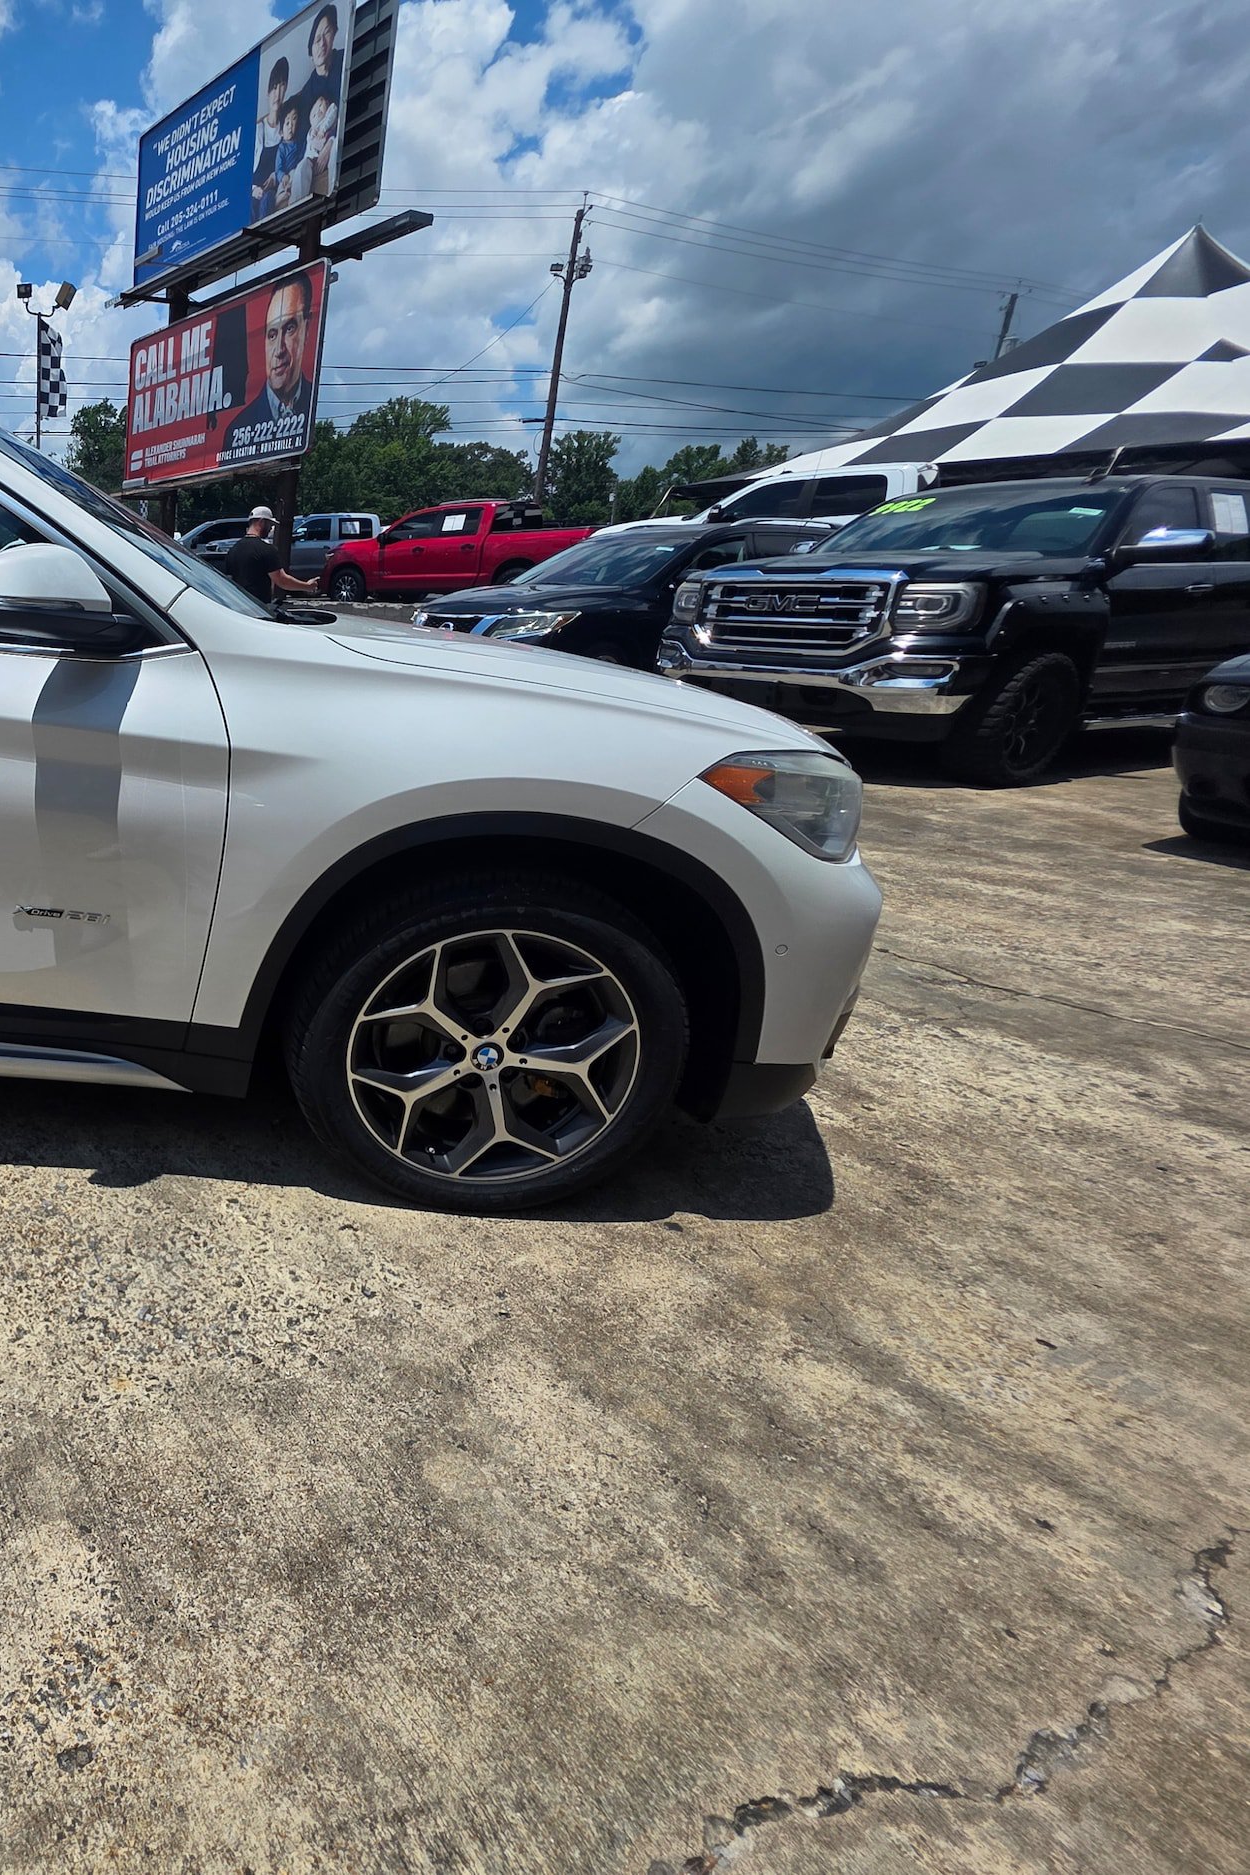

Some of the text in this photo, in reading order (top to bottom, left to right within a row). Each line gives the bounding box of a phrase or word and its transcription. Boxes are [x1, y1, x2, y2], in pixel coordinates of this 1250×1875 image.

[171, 112, 199, 146] DIDN'T
[199, 85, 236, 125] EXPECT
[145, 126, 241, 209] DISCRIMINATION
[166, 118, 218, 173] HOUSING
[145, 205, 161, 221] WOULD
[161, 196, 173, 211] KEEP
[174, 192, 181, 202] US
[181, 183, 195, 198] FROM
[195, 175, 206, 189] OUR
[206, 167, 219, 182] NEW
[157, 189, 218, 236] Call 205-324-0111
[184, 219, 193, 230] LAW
[206, 205, 217, 216] YOUR
[135, 321, 212, 391] CALL ME
[132, 365, 232, 435] ALABAMA.
[145, 440, 173, 458] ALEXANDER
[145, 448, 186, 468] TRIAL ATTORNEYS
[216, 450, 232, 462] OFFICE
[295, 436, 302, 448] AL
[744, 594, 820, 612] GMC
